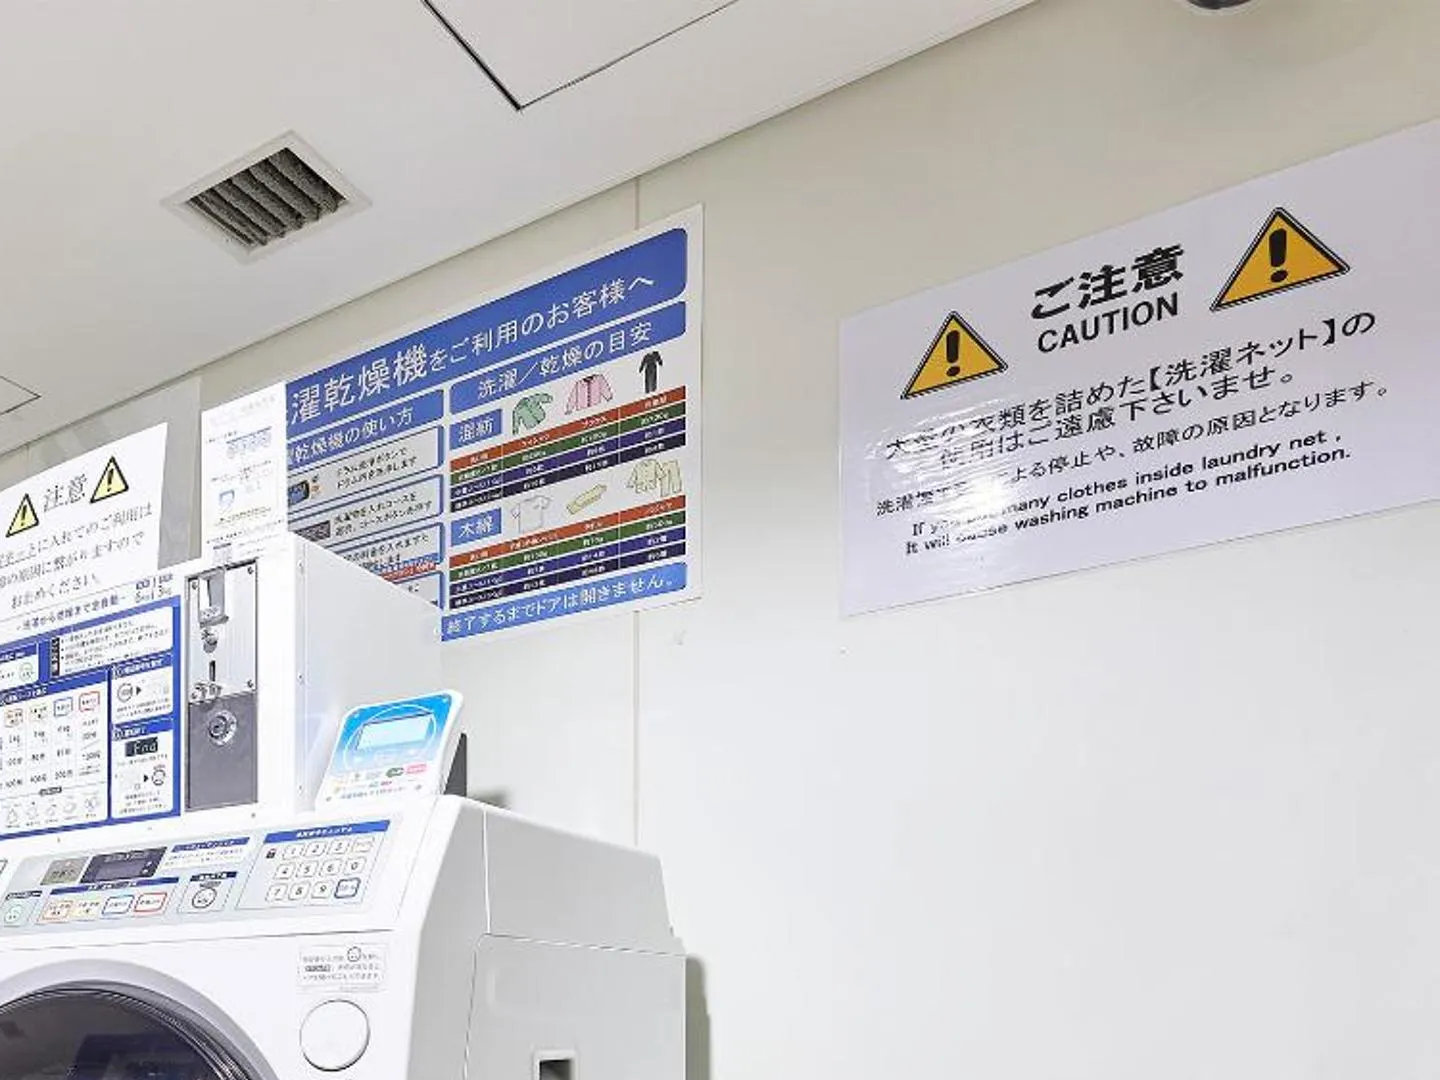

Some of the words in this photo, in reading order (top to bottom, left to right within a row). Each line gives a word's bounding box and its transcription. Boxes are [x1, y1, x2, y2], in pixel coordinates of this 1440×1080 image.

[1030, 243, 1185, 321] ご注意
[1036, 292, 1180, 353] CAUTION
[291, 406, 414, 465] 乾燥機の使い方
[912, 521, 925, 536] If
[1057, 475, 1128, 502] clothes
[1135, 462, 1194, 485] inside
[1202, 439, 1281, 470] laundry
[1289, 429, 1328, 450] net
[1015, 504, 1089, 531] washing
[1096, 481, 1178, 513] machine
[1186, 478, 1207, 493] to
[1216, 447, 1351, 487] malfunction.
